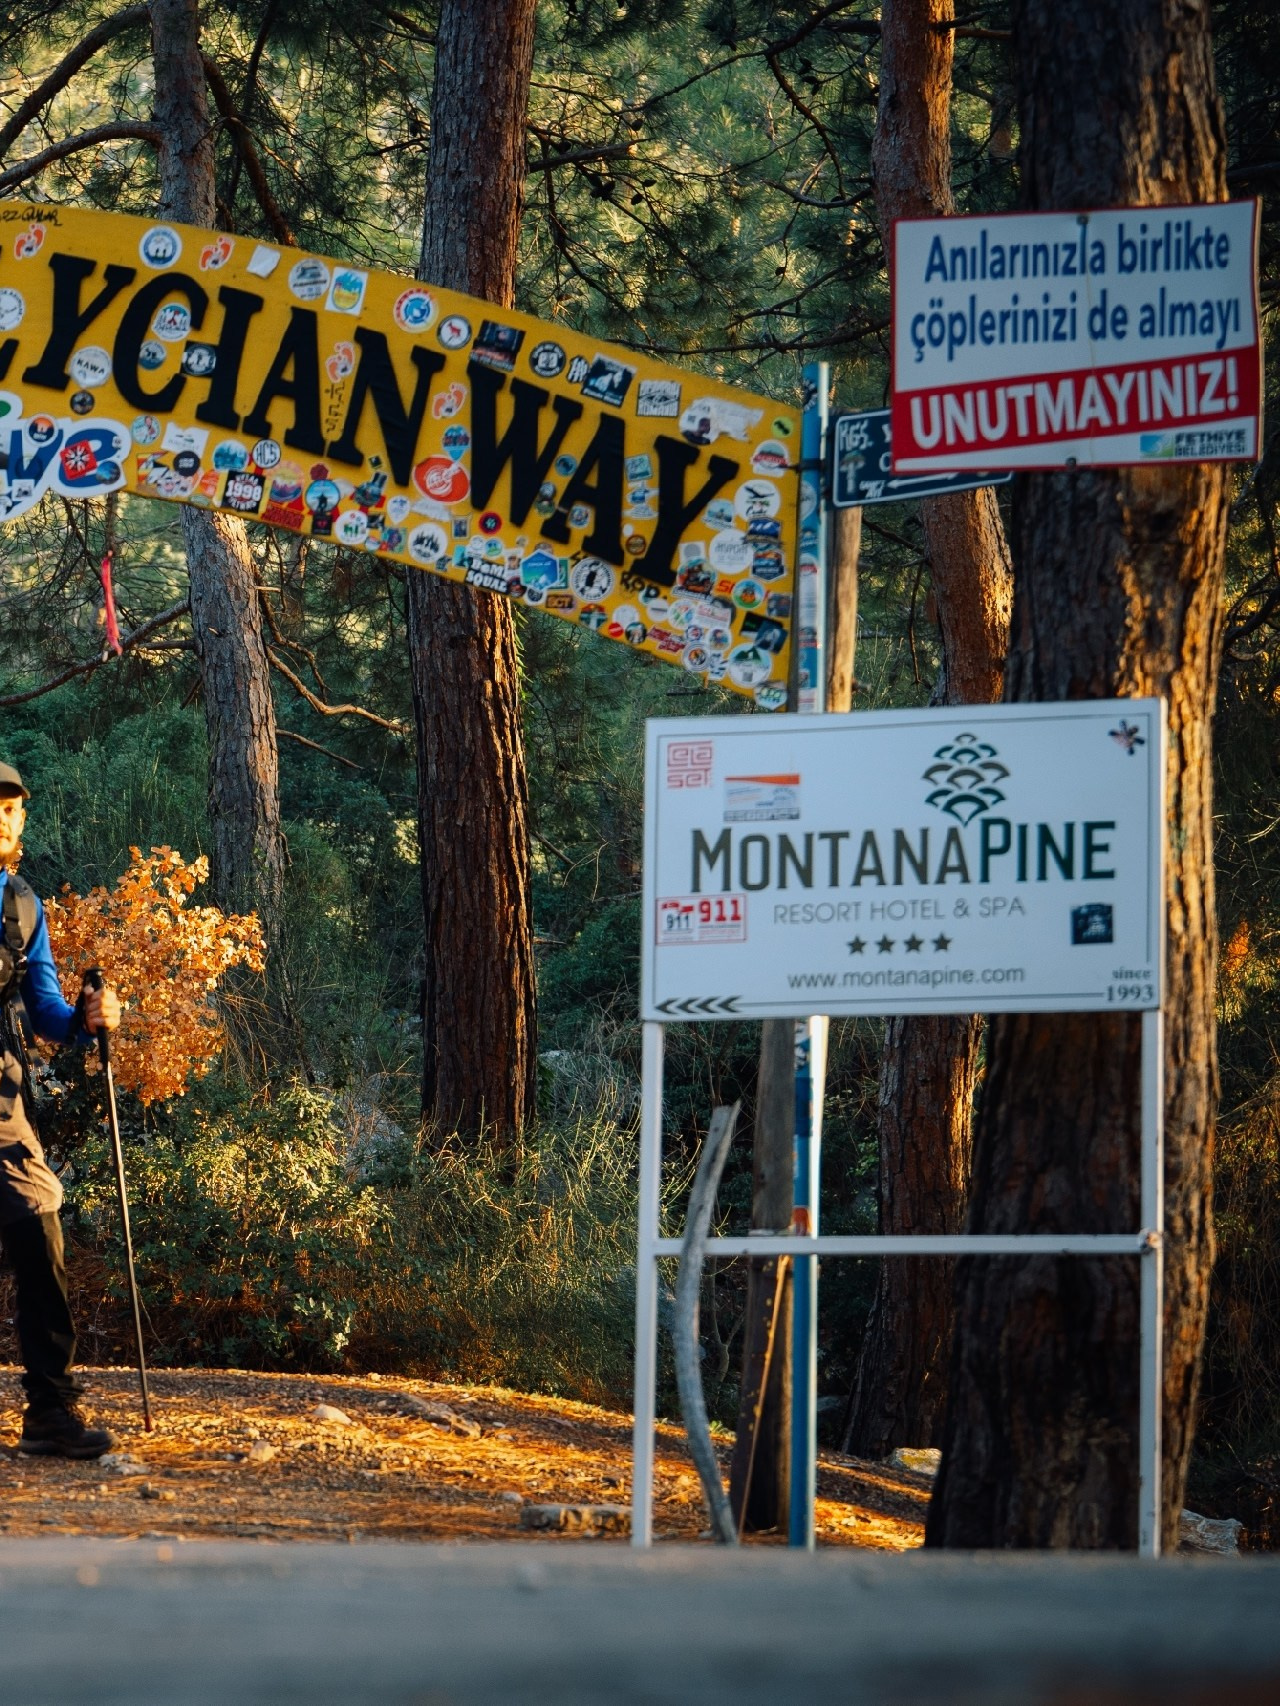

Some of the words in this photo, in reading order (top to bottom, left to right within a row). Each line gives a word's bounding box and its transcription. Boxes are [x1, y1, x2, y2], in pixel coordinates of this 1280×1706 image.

[923, 228, 1106, 284] Anılarınızla
[1118, 219, 1230, 275] birlikte
[910, 292, 1079, 363] çöplerinizi
[1087, 288, 1129, 340] de
[1138, 286, 1241, 351] almayı
[909, 356, 1239, 451] UNUTMAYINIZ!
[466, 358, 740, 588] WAY
[224, 479, 263, 502] 1998
[666, 912, 692, 932] 911
[698, 899, 742, 923] 911
[773, 901, 863, 926] RESORT
[870, 899, 946, 922] HOTEL
[953, 898, 970, 919] &
[978, 896, 1026, 918] SPA
[787, 965, 1025, 990] www.montanapine.com
[1112, 967, 1151, 981] since
[1105, 984, 1155, 1004] 1993
